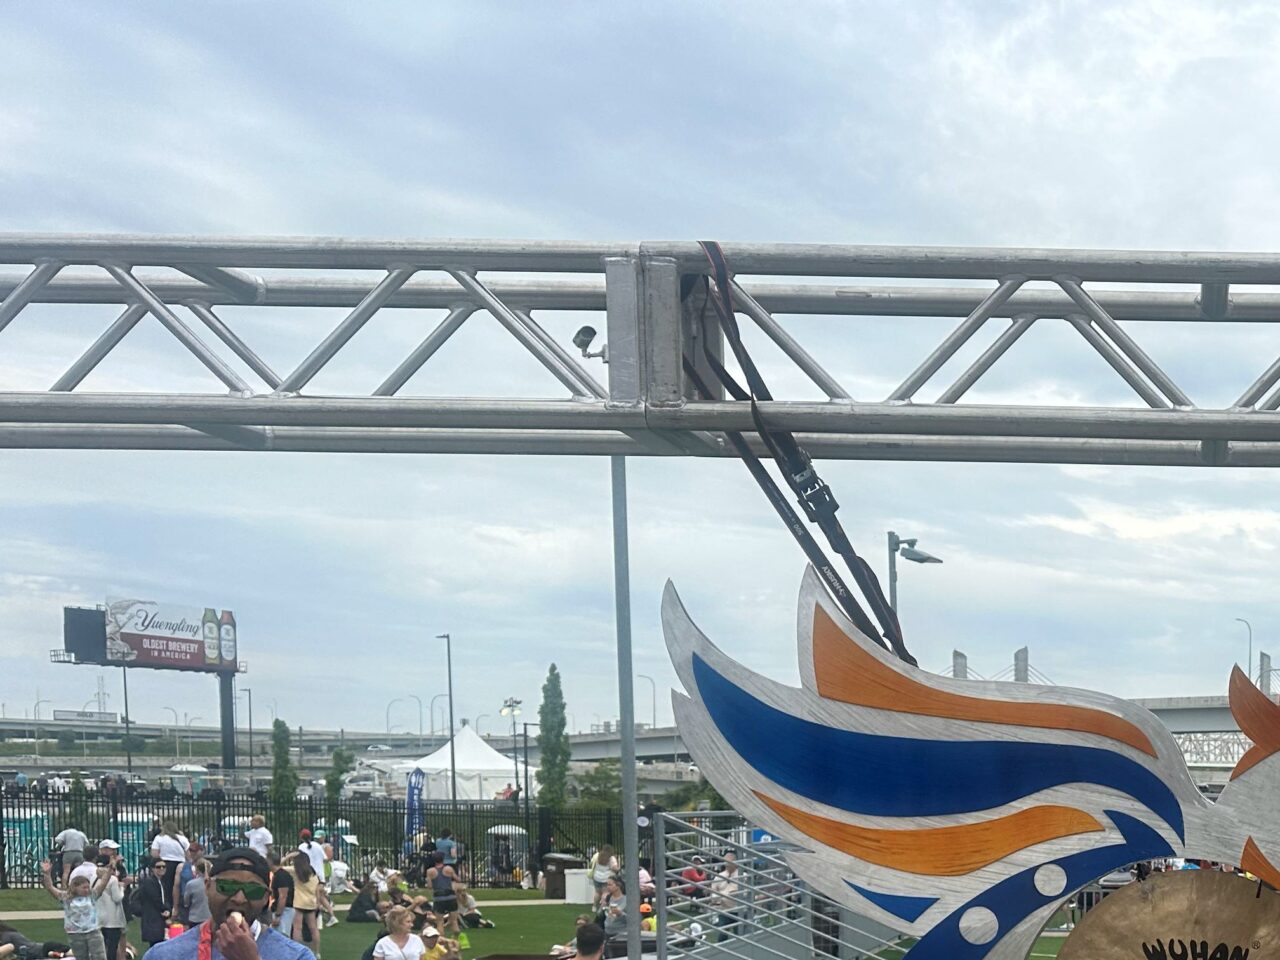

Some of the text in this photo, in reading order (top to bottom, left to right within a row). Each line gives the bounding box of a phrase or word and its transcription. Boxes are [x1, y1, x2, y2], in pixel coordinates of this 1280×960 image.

[134, 608, 201, 637] Yuengling
[142, 638, 167, 650] OLDEST
[168, 642, 198, 653] BREWERY
[161, 651, 191, 660] AMERICA
